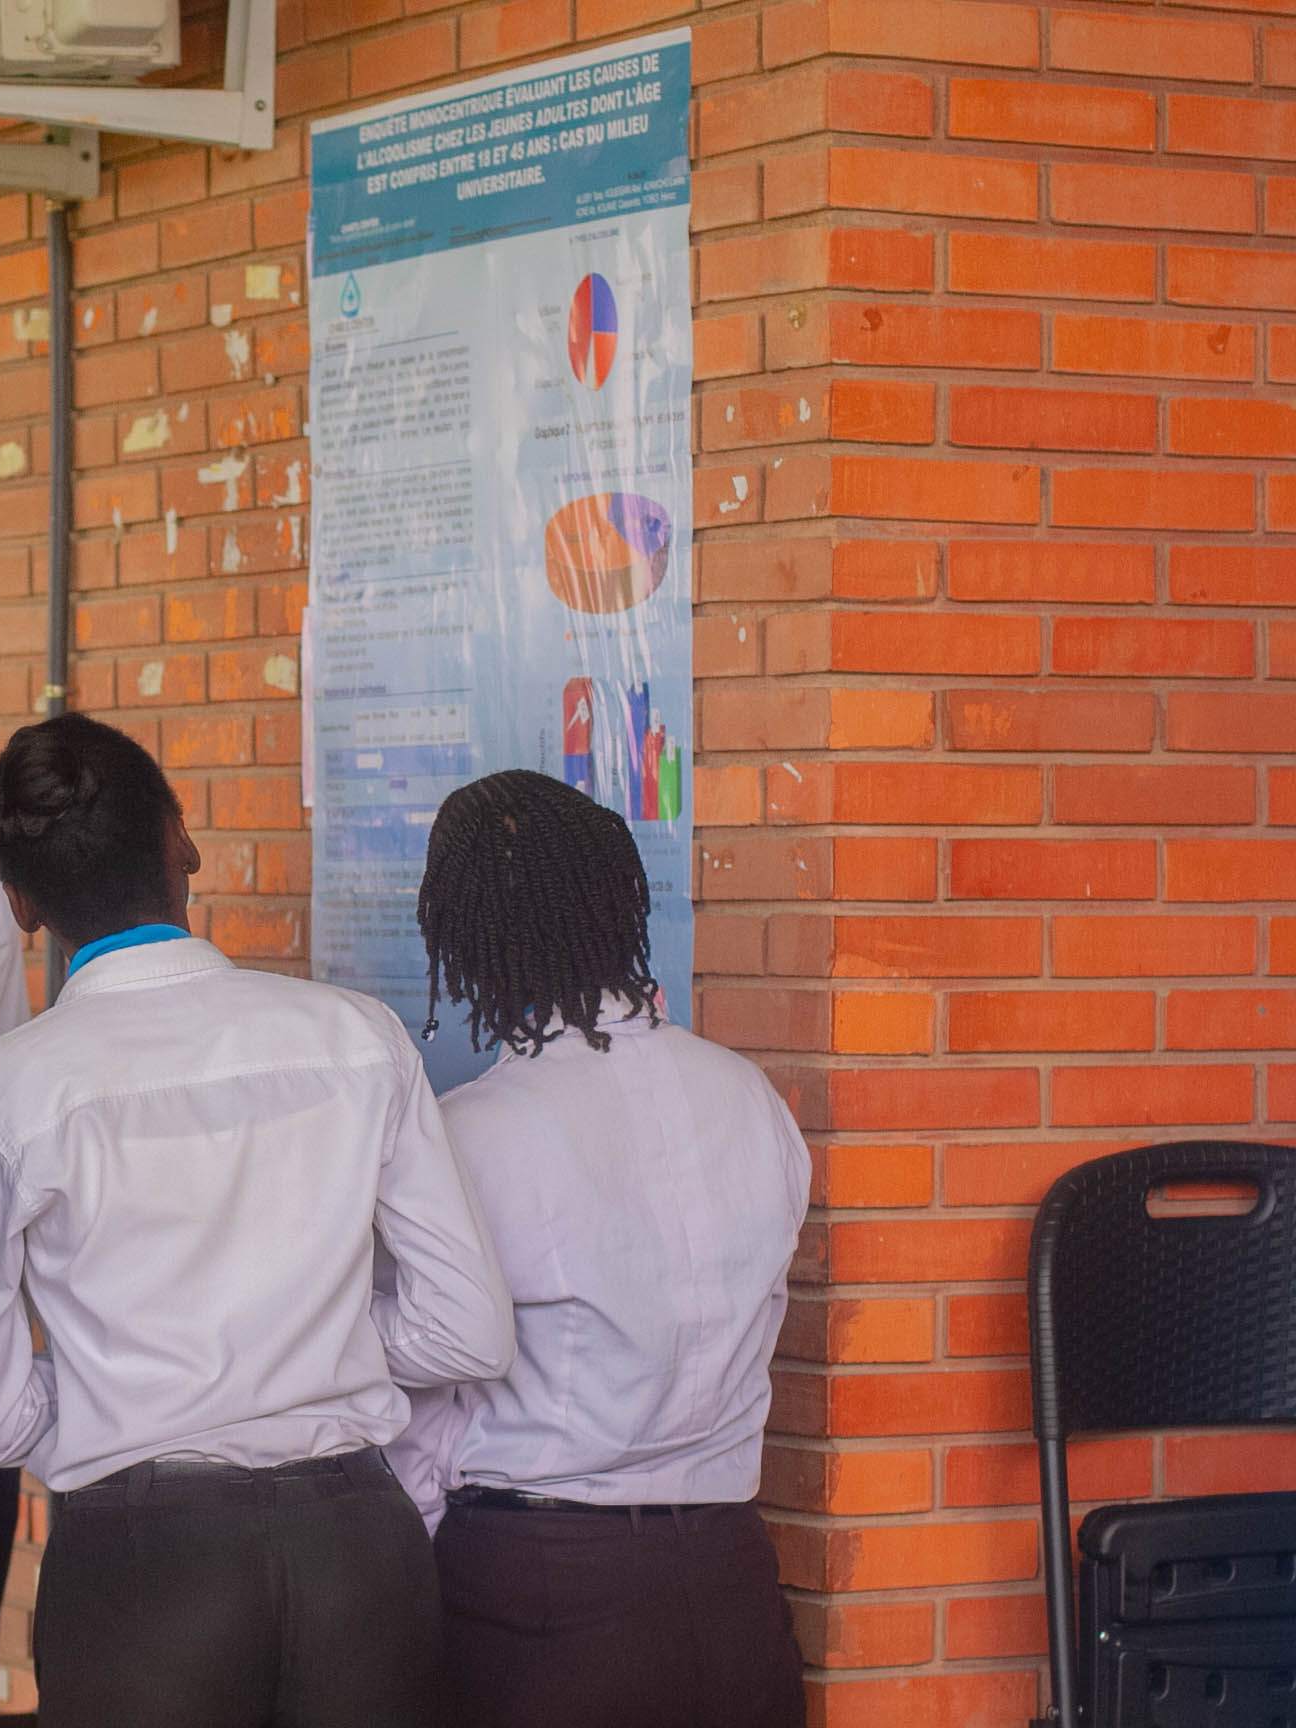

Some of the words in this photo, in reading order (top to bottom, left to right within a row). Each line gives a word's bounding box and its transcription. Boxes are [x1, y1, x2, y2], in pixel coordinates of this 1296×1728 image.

[357, 135, 433, 170] L'ALCOOLISME
[434, 128, 464, 151] CHEZ
[466, 123, 486, 144] LES
[488, 111, 533, 138] JEUNES
[535, 99, 588, 128] ADULTES
[590, 90, 624, 115] DONT
[626, 82, 662, 107] L'ÂGE
[409, 91, 504, 131] MONOCENTRIQUE
[568, 69, 592, 91] LES
[594, 58, 640, 85] CAUSES
[642, 53, 660, 74] DE
[367, 173, 388, 194] EST
[390, 162, 438, 189] COMPRIS
[439, 153, 475, 177] ENTRE
[493, 145, 509, 165] ET
[510, 141, 525, 160] 45
[527, 135, 551, 157] ANS
[559, 127, 585, 150] CAS
[587, 124, 604, 145] DU
[607, 114, 649, 140] MILIEU
[457, 166, 546, 200] UNIVERSITAIRE.
